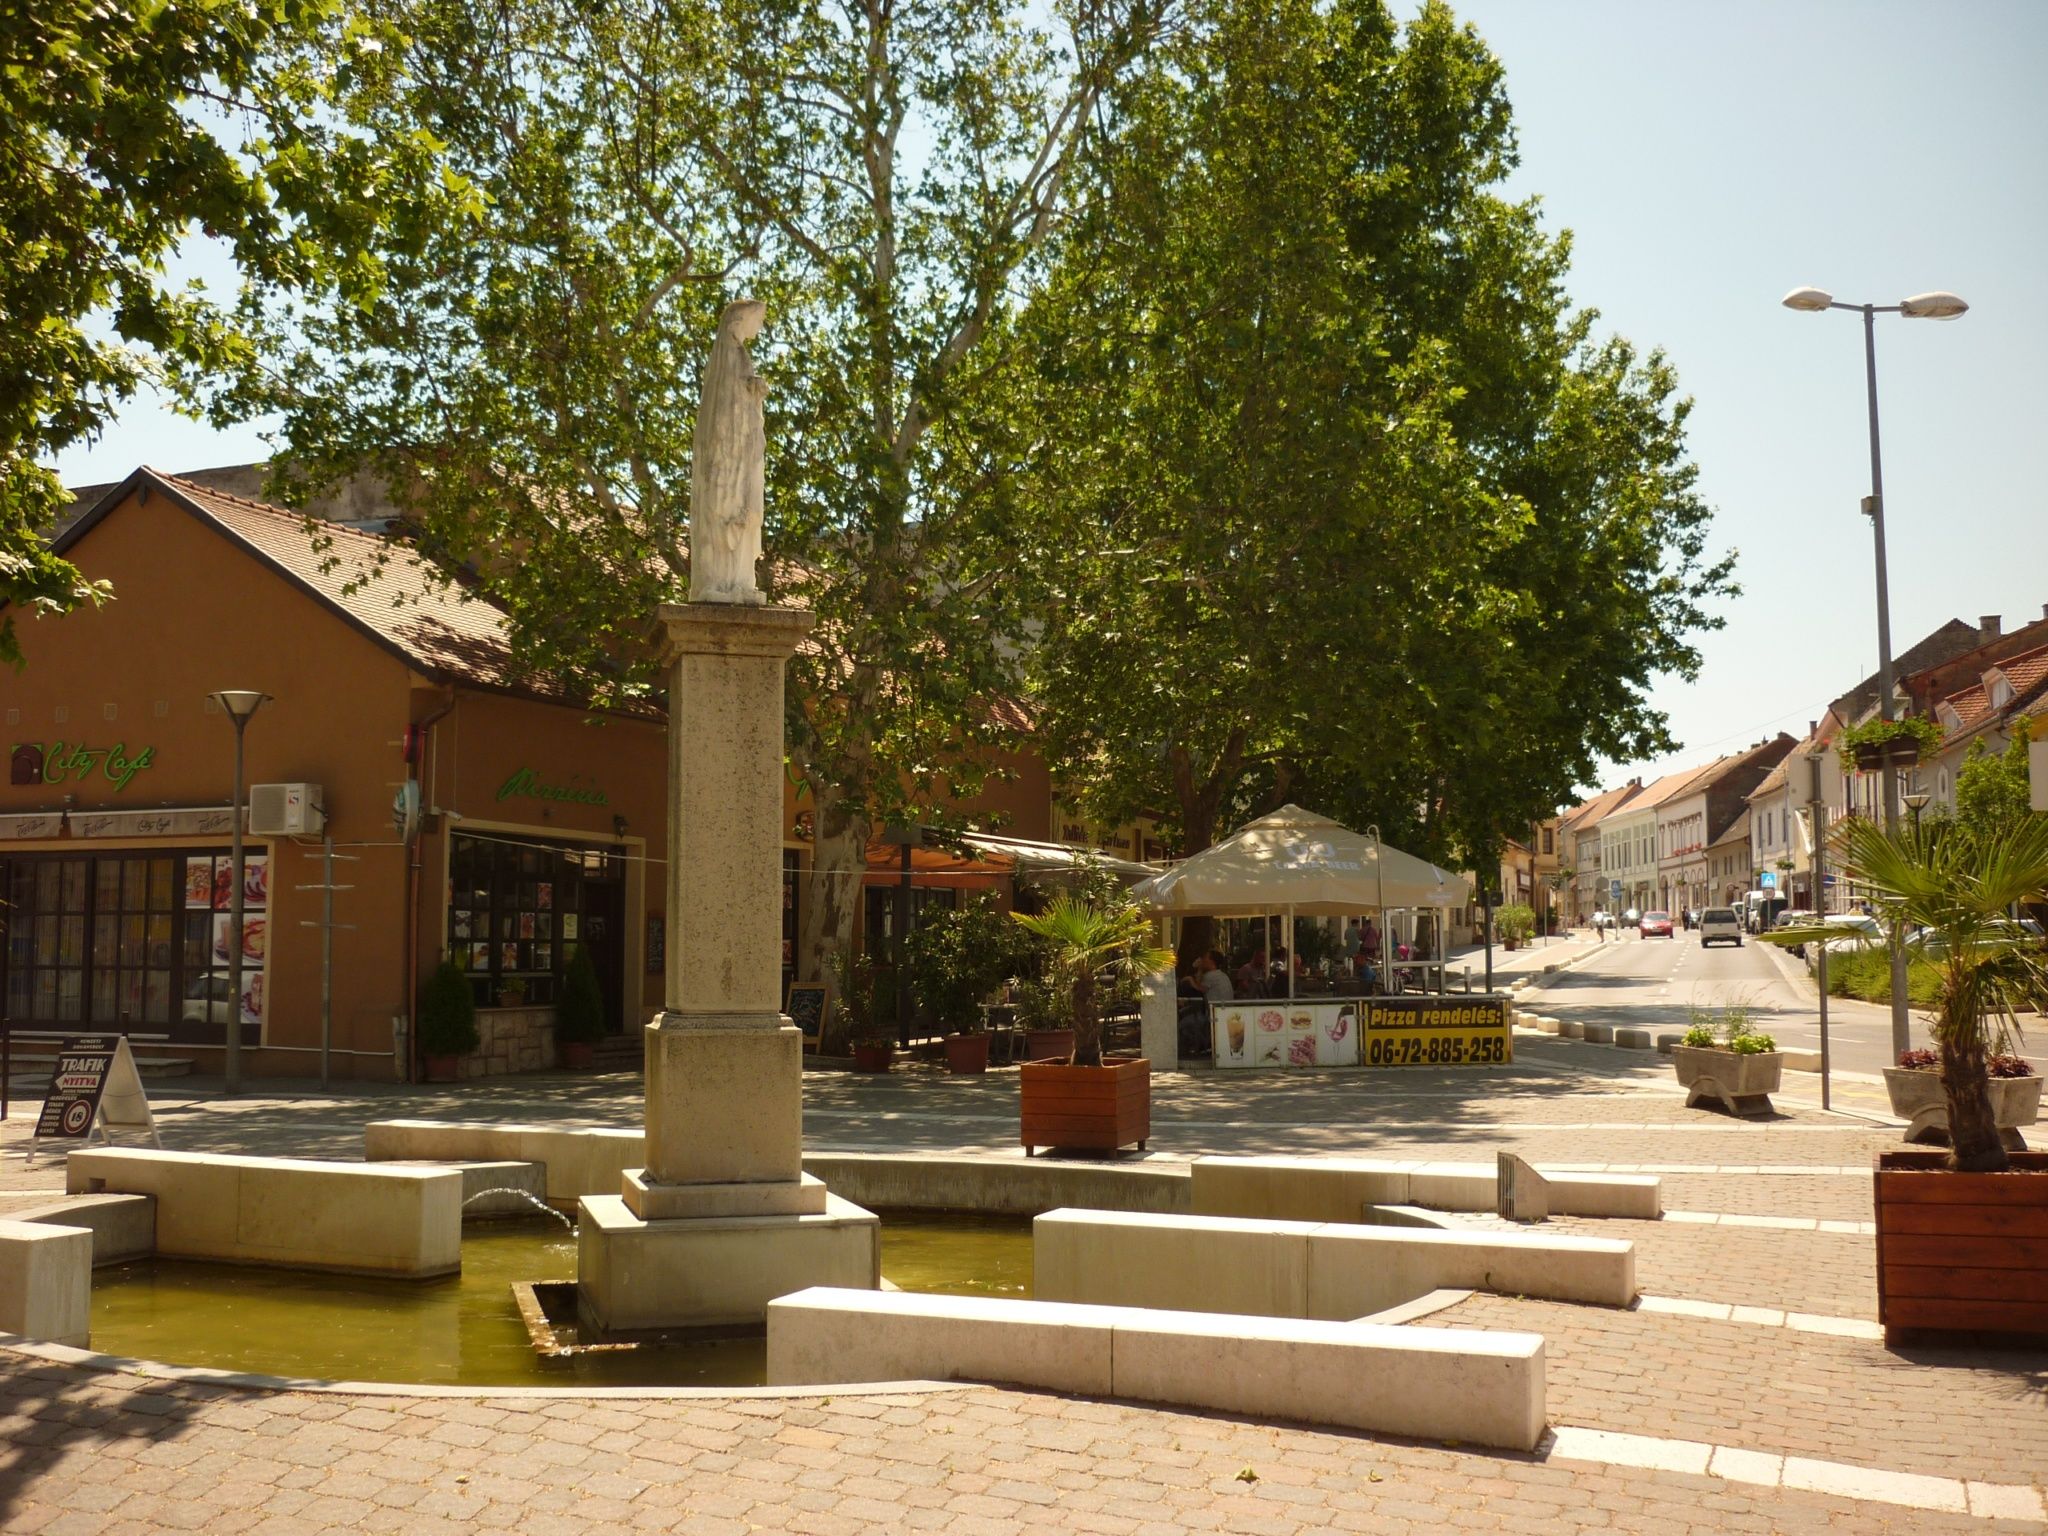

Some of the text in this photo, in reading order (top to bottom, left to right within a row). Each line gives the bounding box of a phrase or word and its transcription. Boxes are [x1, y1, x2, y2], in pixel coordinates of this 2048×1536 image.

[43, 742, 155, 792] City Café
[1371, 1006, 1501, 1025] Pizza rendelés:
[1370, 1036, 1504, 1064] 06-72-885-258
[61, 1058, 107, 1072] TRAFIK
[62, 1076, 97, 1087] NYITVA
[71, 1111, 84, 1122] 18
